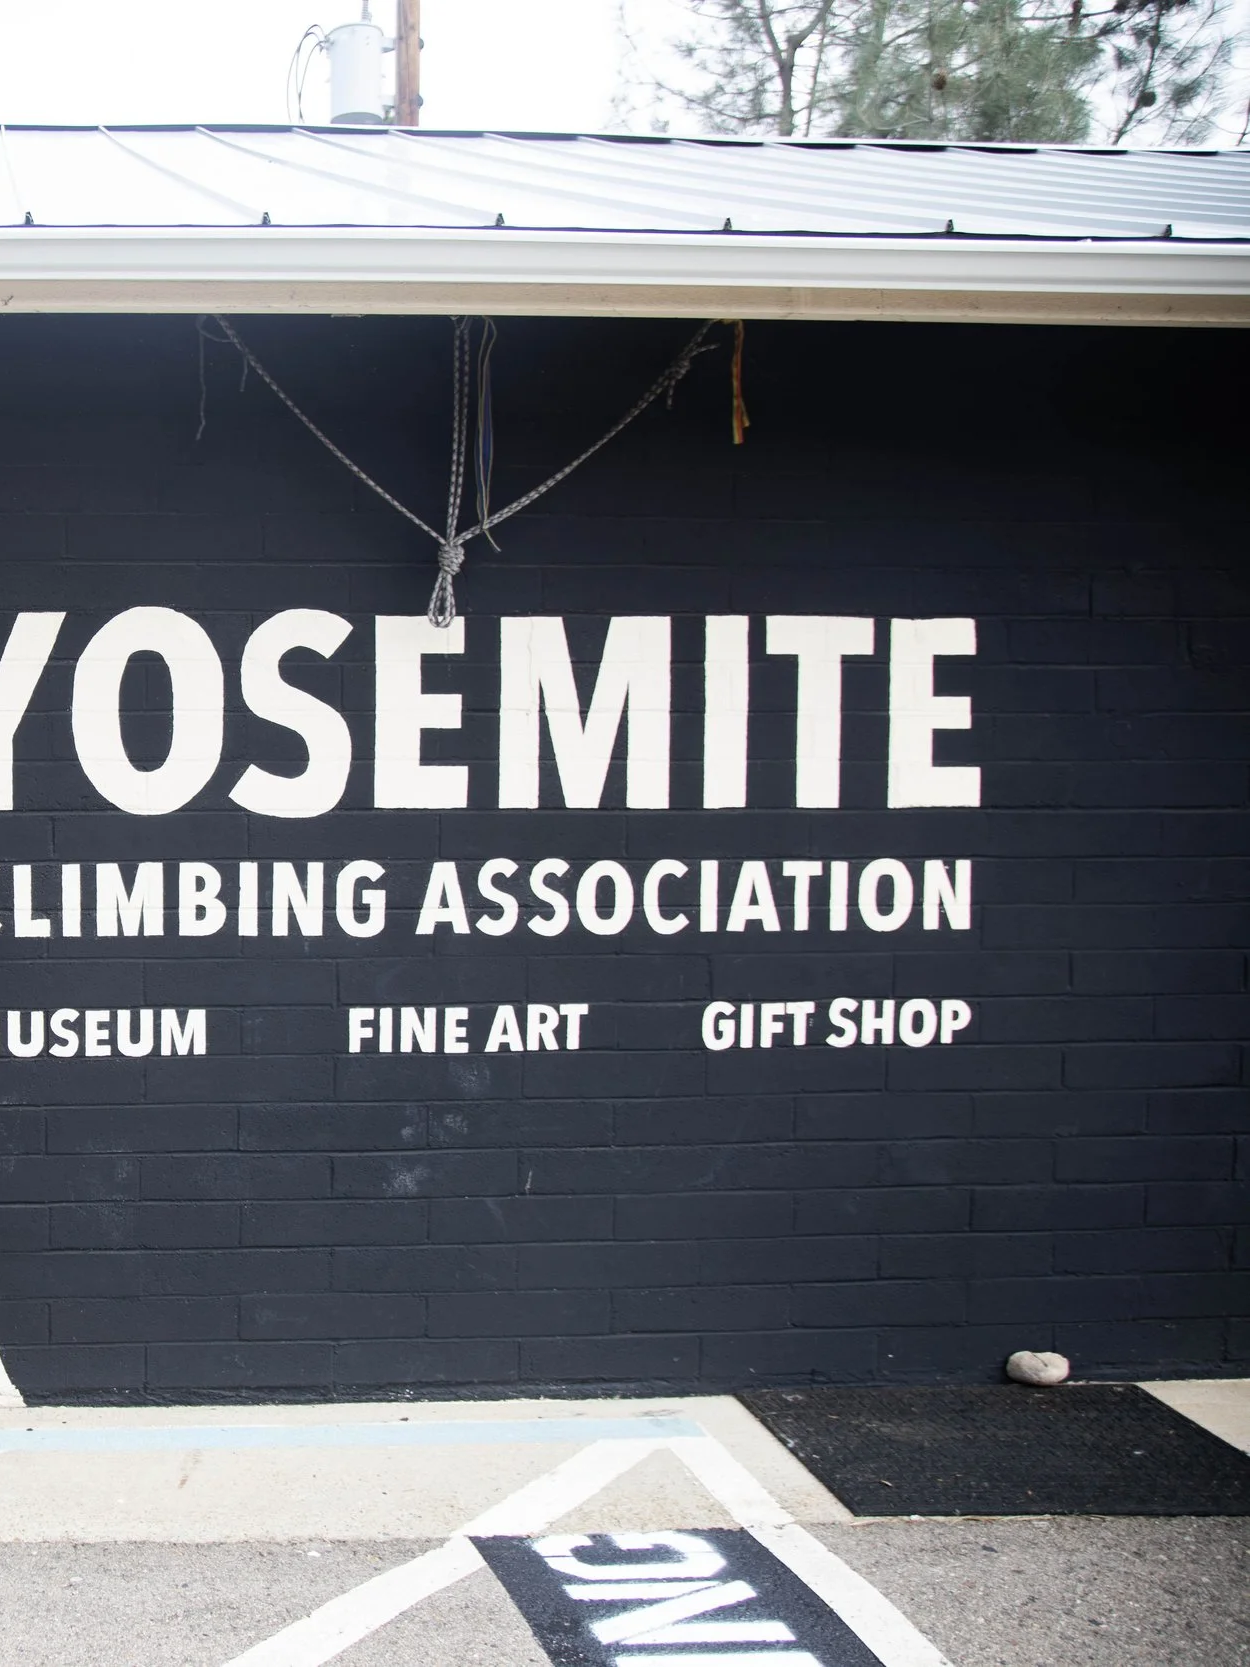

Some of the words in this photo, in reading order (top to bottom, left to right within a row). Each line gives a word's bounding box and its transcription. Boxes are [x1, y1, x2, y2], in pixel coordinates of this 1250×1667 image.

[414, 858, 972, 937] ASSOCIATION
[349, 1006, 470, 1054] FINE
[483, 1003, 589, 1053] ART
[701, 1000, 816, 1051] GIFT
[825, 998, 972, 1049] SHOP
